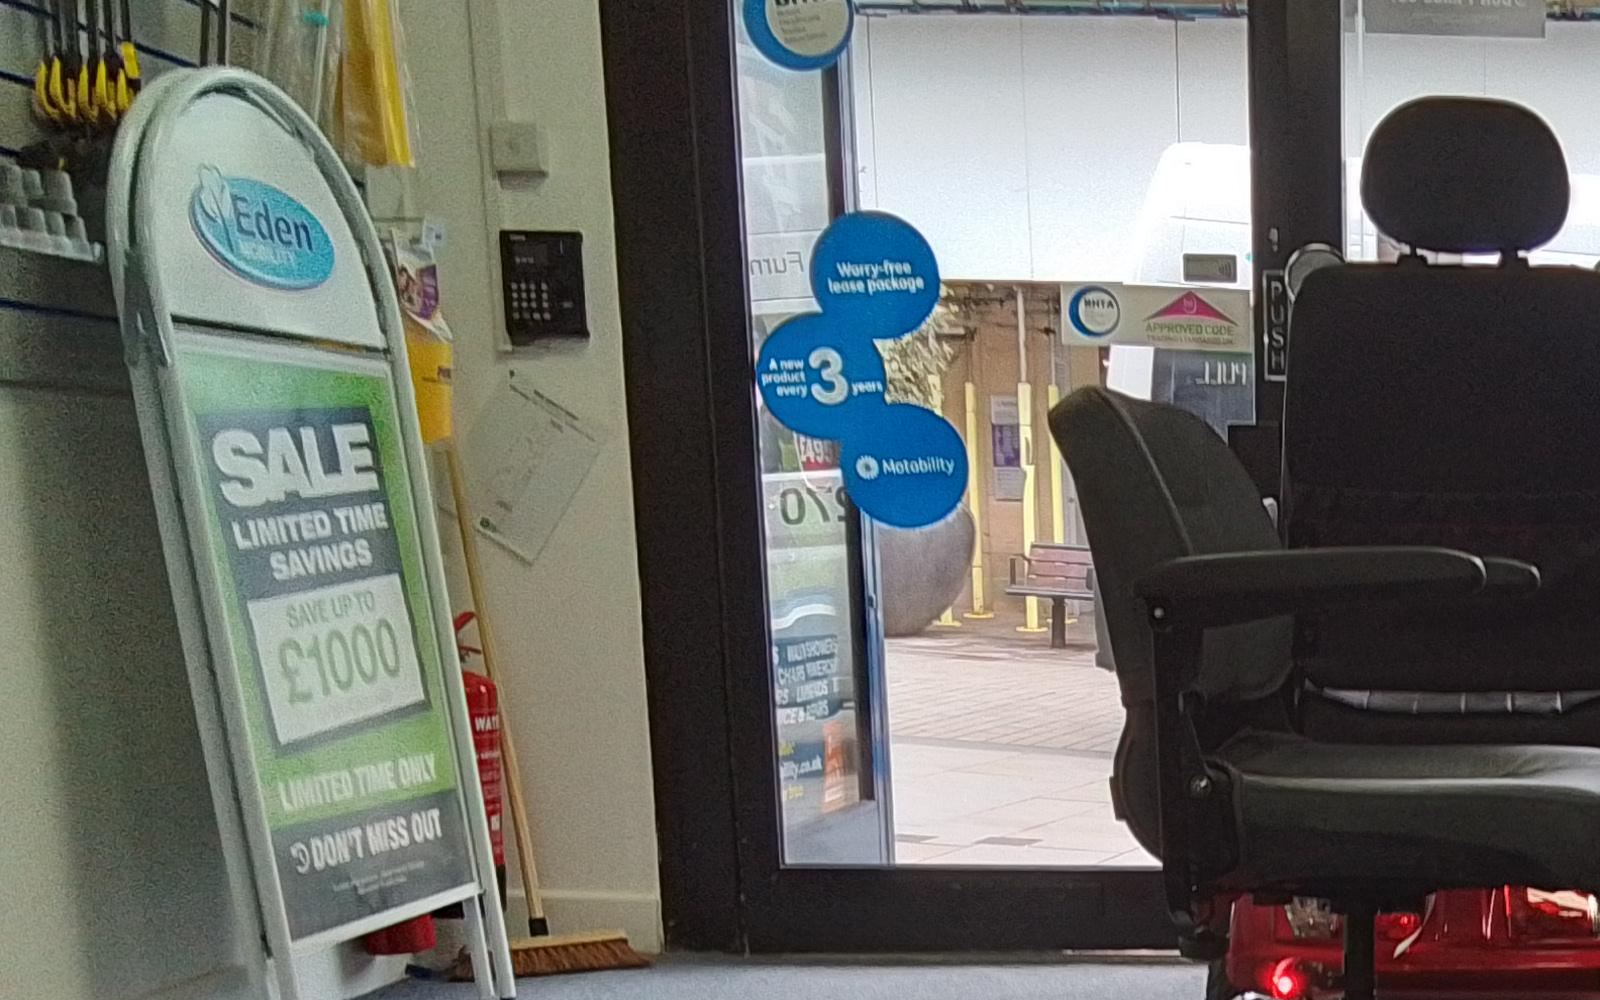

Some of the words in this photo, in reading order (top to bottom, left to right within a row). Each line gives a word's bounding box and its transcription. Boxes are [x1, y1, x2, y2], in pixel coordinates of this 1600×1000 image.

[231, 194, 314, 252] Eden
[827, 277, 865, 294] lease
[867, 275, 925, 296] package
[836, 259, 912, 279] Worry-free
[1145, 322, 1204, 336] APPROVED
[1204, 324, 1235, 337] CODE
[1270, 280, 1285, 370] PUSH
[761, 370, 806, 387] product
[768, 358, 778, 371] A
[779, 358, 805, 371] new
[776, 383, 808, 398] every
[808, 346, 850, 405] 3
[851, 379, 884, 396] years
[212, 422, 380, 508] SALE
[881, 456, 955, 477] Motability
[231, 510, 332, 551] LIMITED
[333, 502, 389, 535] TIME
[269, 538, 373, 580] SAVINGS
[285, 600, 331, 629] SAVE
[331, 594, 352, 618] UP
[352, 590, 375, 615] TO
[278, 618, 400, 707] £1000
[278, 769, 354, 812] LIMITED
[353, 760, 399, 796] TIME
[397, 752, 437, 788] ONLY
[310, 826, 364, 872] DON'T
[366, 815, 411, 856] MISS
[411, 808, 443, 844] OUT
